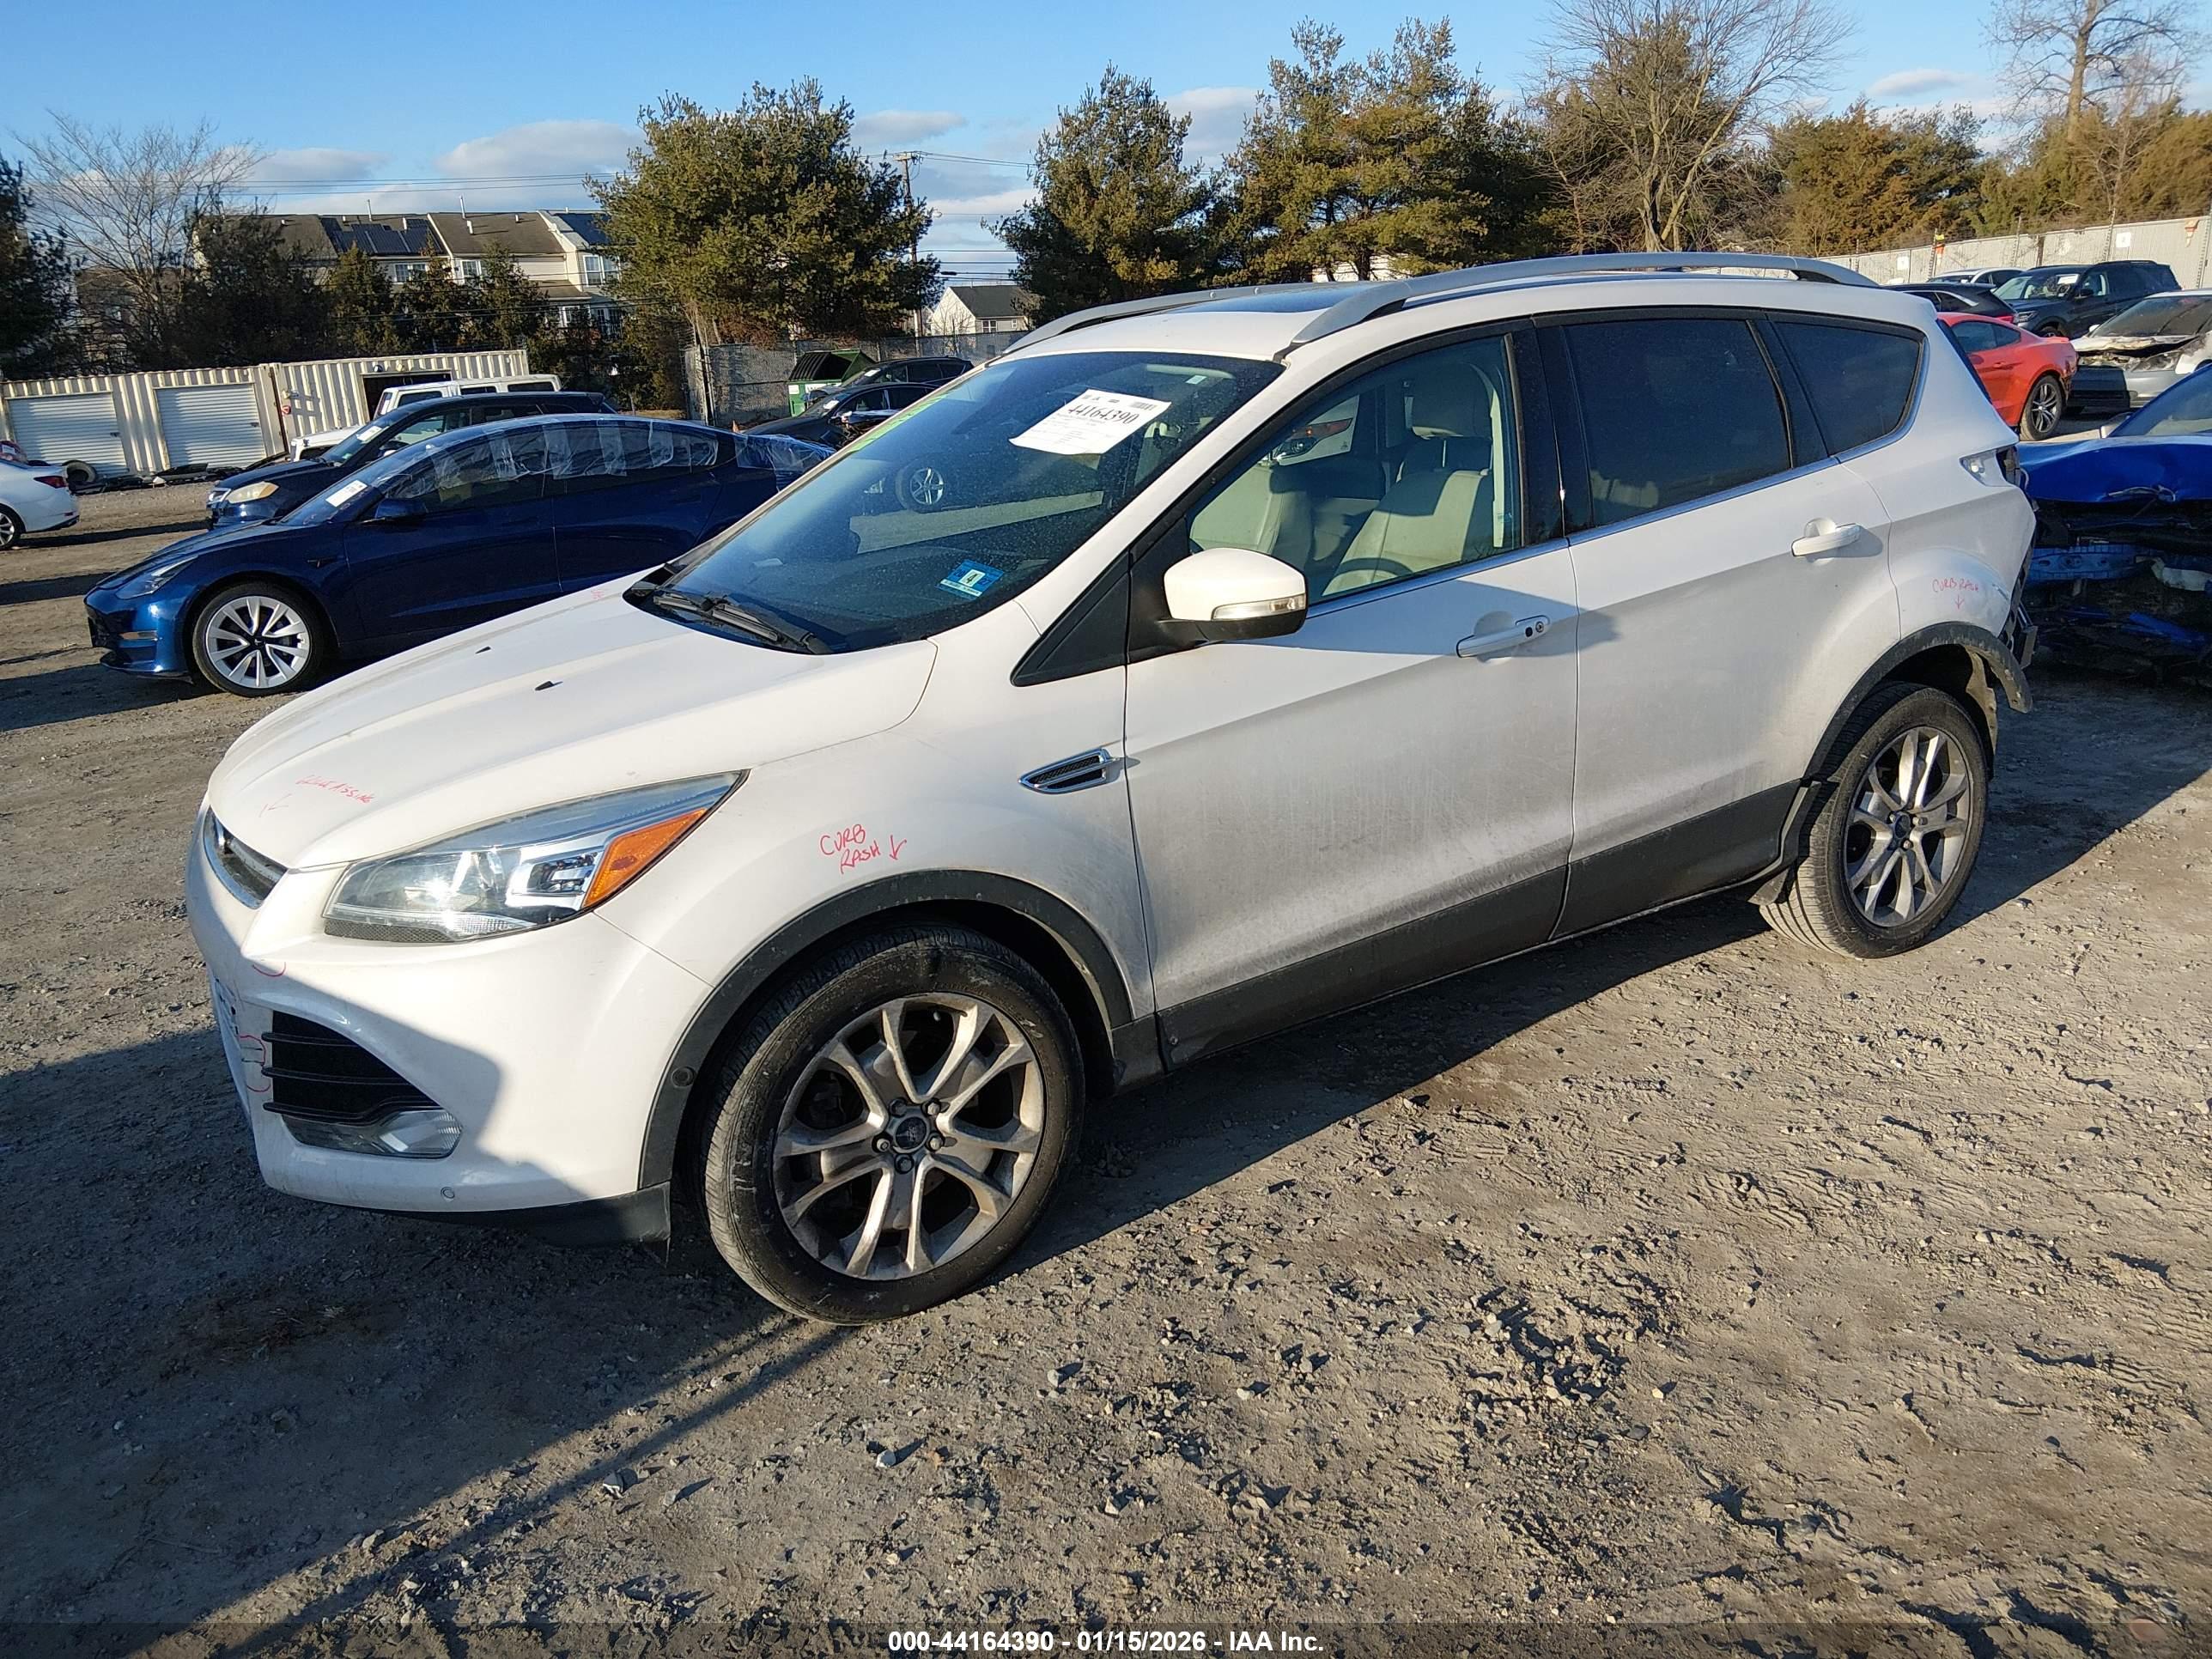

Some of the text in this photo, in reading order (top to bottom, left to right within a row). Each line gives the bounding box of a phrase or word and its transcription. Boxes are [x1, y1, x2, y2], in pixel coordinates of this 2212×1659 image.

[1068, 404, 1140, 424] 44164390
[966, 573, 978, 584] 4
[820, 823, 866, 855] CURB
[840, 840, 881, 874] RASH
